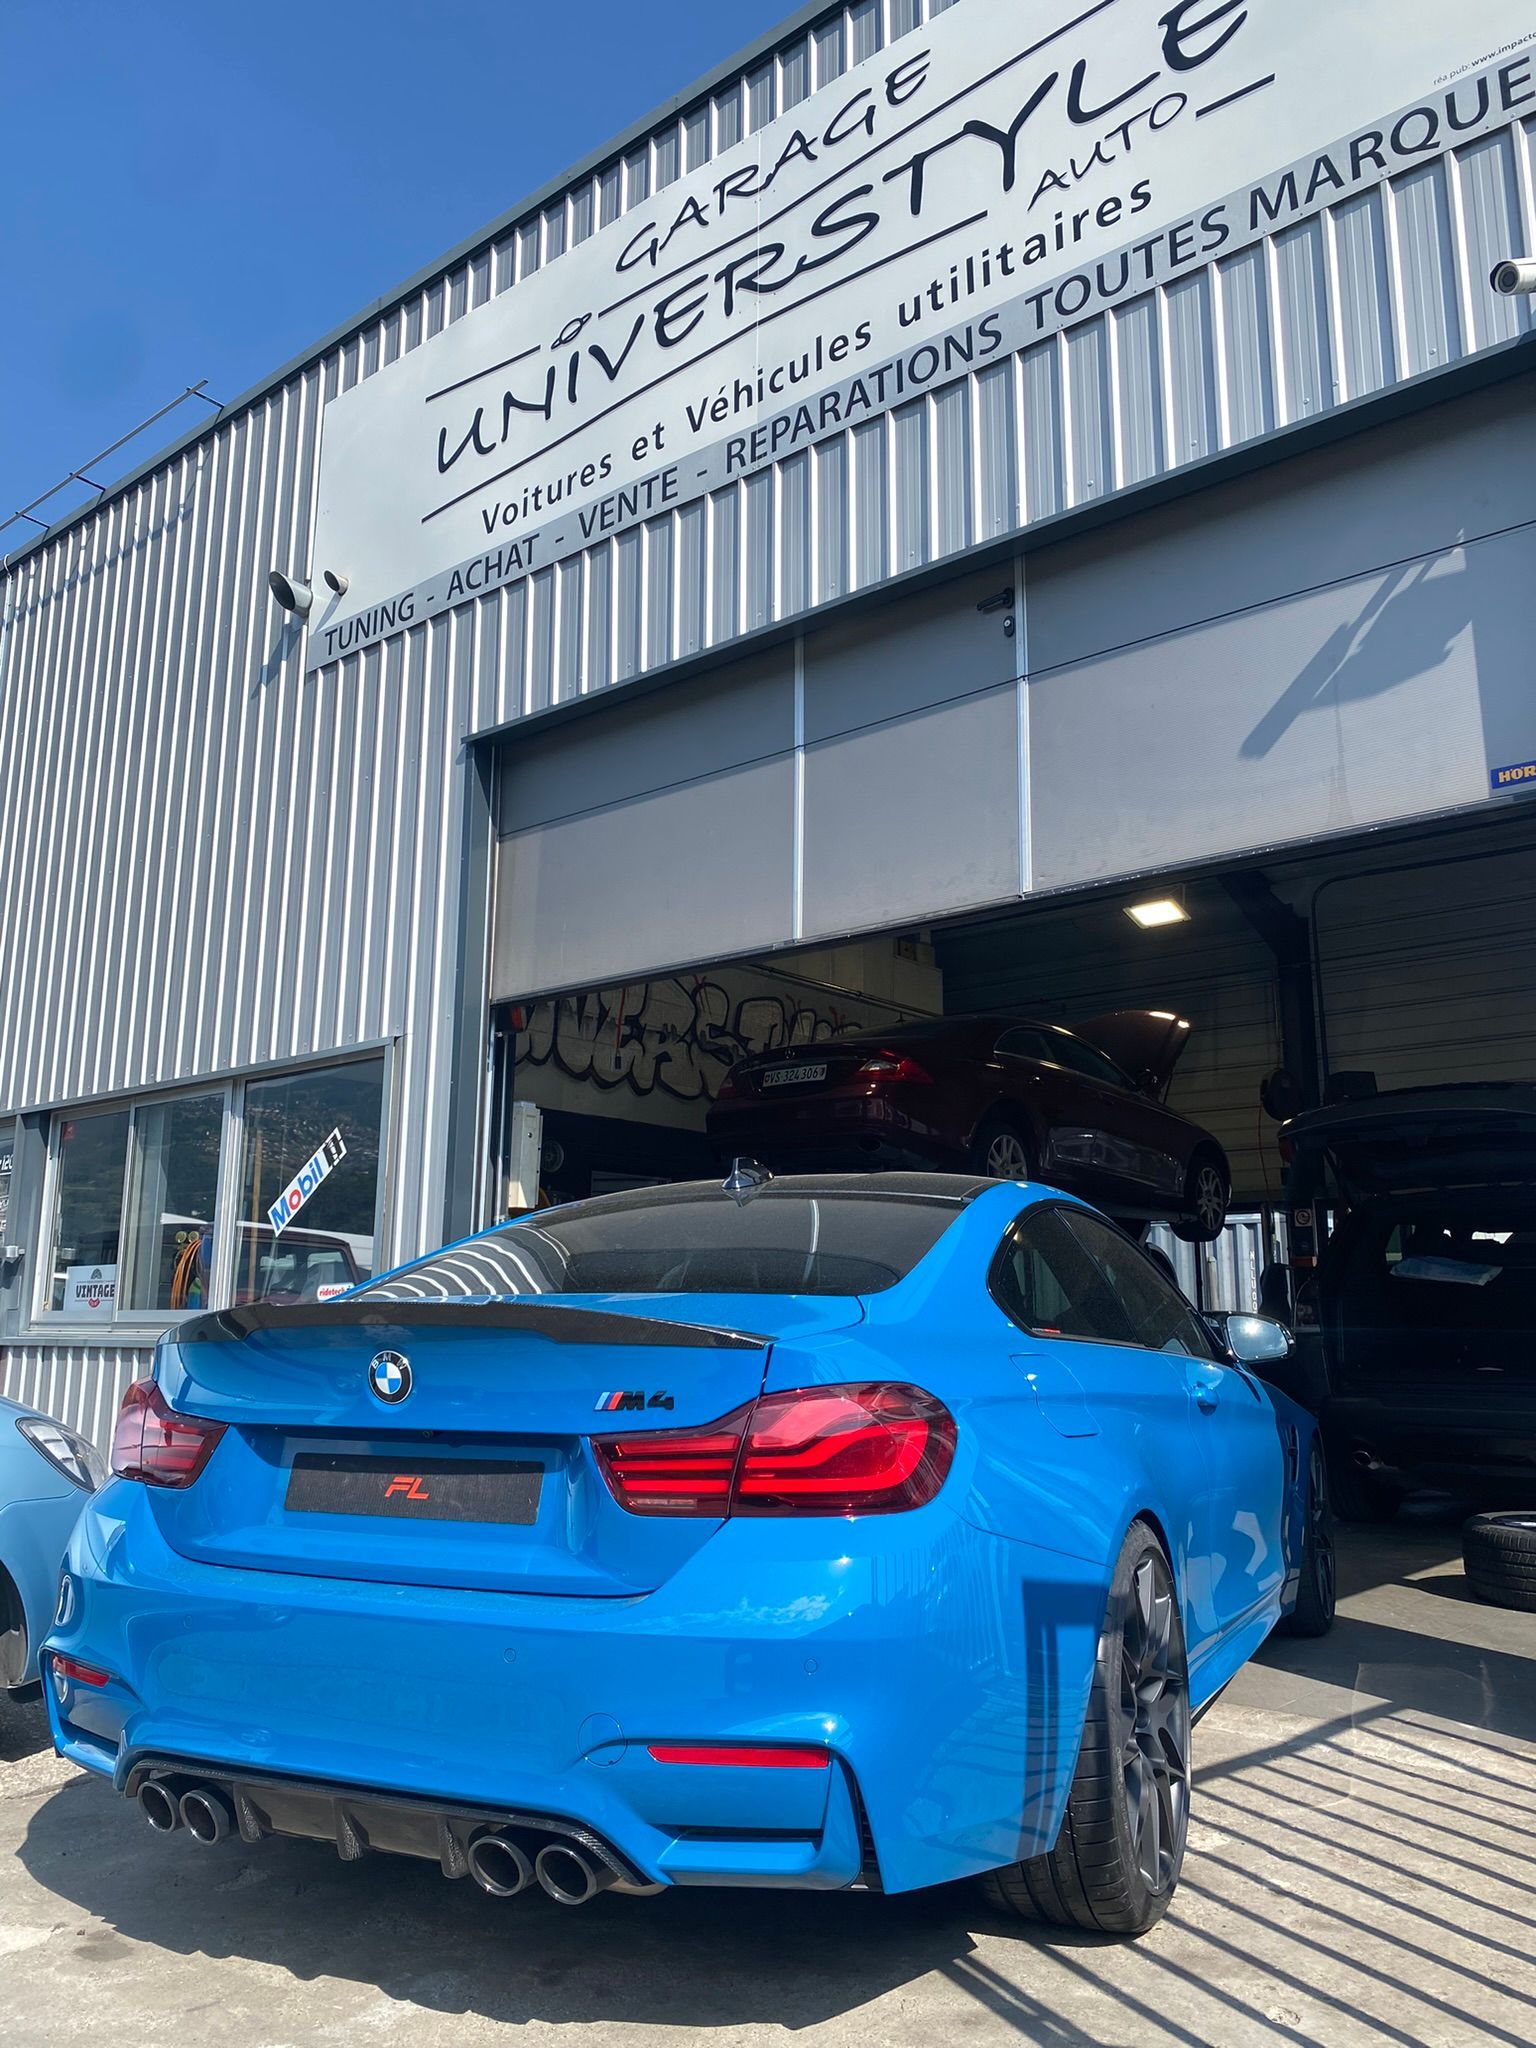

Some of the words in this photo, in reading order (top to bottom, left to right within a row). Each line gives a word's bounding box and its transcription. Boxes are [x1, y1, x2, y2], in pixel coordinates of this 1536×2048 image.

[615, 48, 931, 273] GARAGE
[1027, 92, 1188, 212] AUTO
[324, 592, 415, 656] TUNING
[446, 532, 541, 602] ACHAT
[577, 466, 679, 540] VENTE
[725, 311, 1003, 475] REPARATIONS
[1024, 204, 1230, 331] TOUTES
[1249, 55, 1536, 231] MARQUE
[481, 454, 612, 535] Voitures
[631, 422, 665, 461] et
[685, 320, 870, 433] Véhicules
[898, 179, 1152, 326] utilitaires
[270, 1156, 325, 1233] Mobil
[75, 1283, 116, 1298] VINTAGE
[371, 1352, 407, 1370] BMW
[615, 1390, 675, 1411] M4
[384, 1476, 429, 1499] FL
